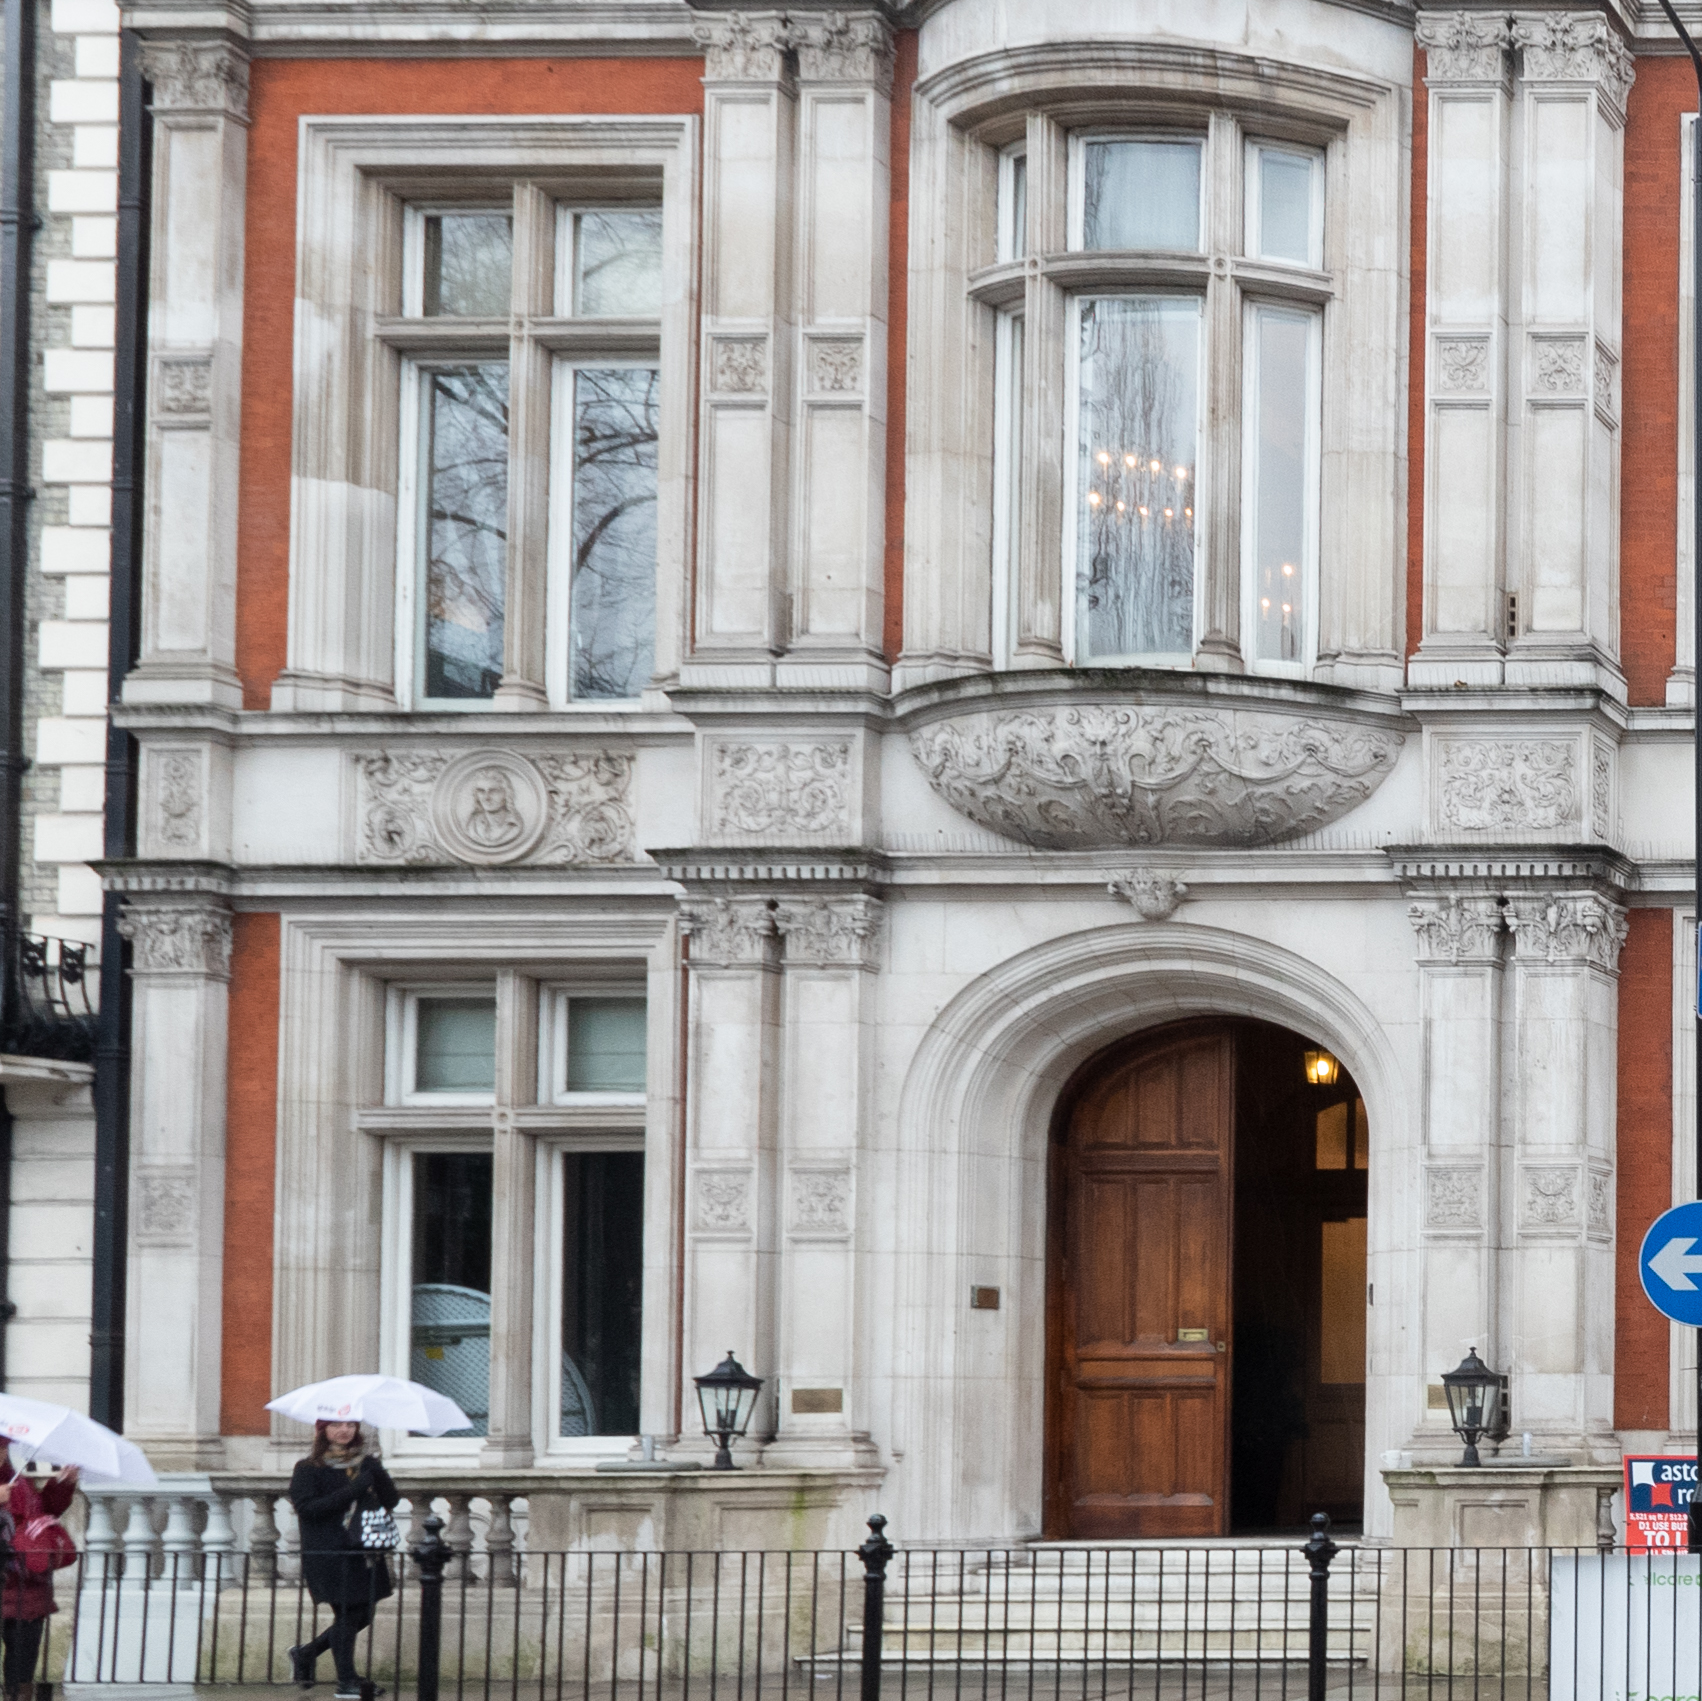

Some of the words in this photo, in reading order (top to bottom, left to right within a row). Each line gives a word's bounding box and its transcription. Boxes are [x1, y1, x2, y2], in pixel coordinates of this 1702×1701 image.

[1638, 1521, 1651, 1531] D1
[1652, 1521, 1670, 1531] USE
[1643, 1530, 1671, 1547] TO
